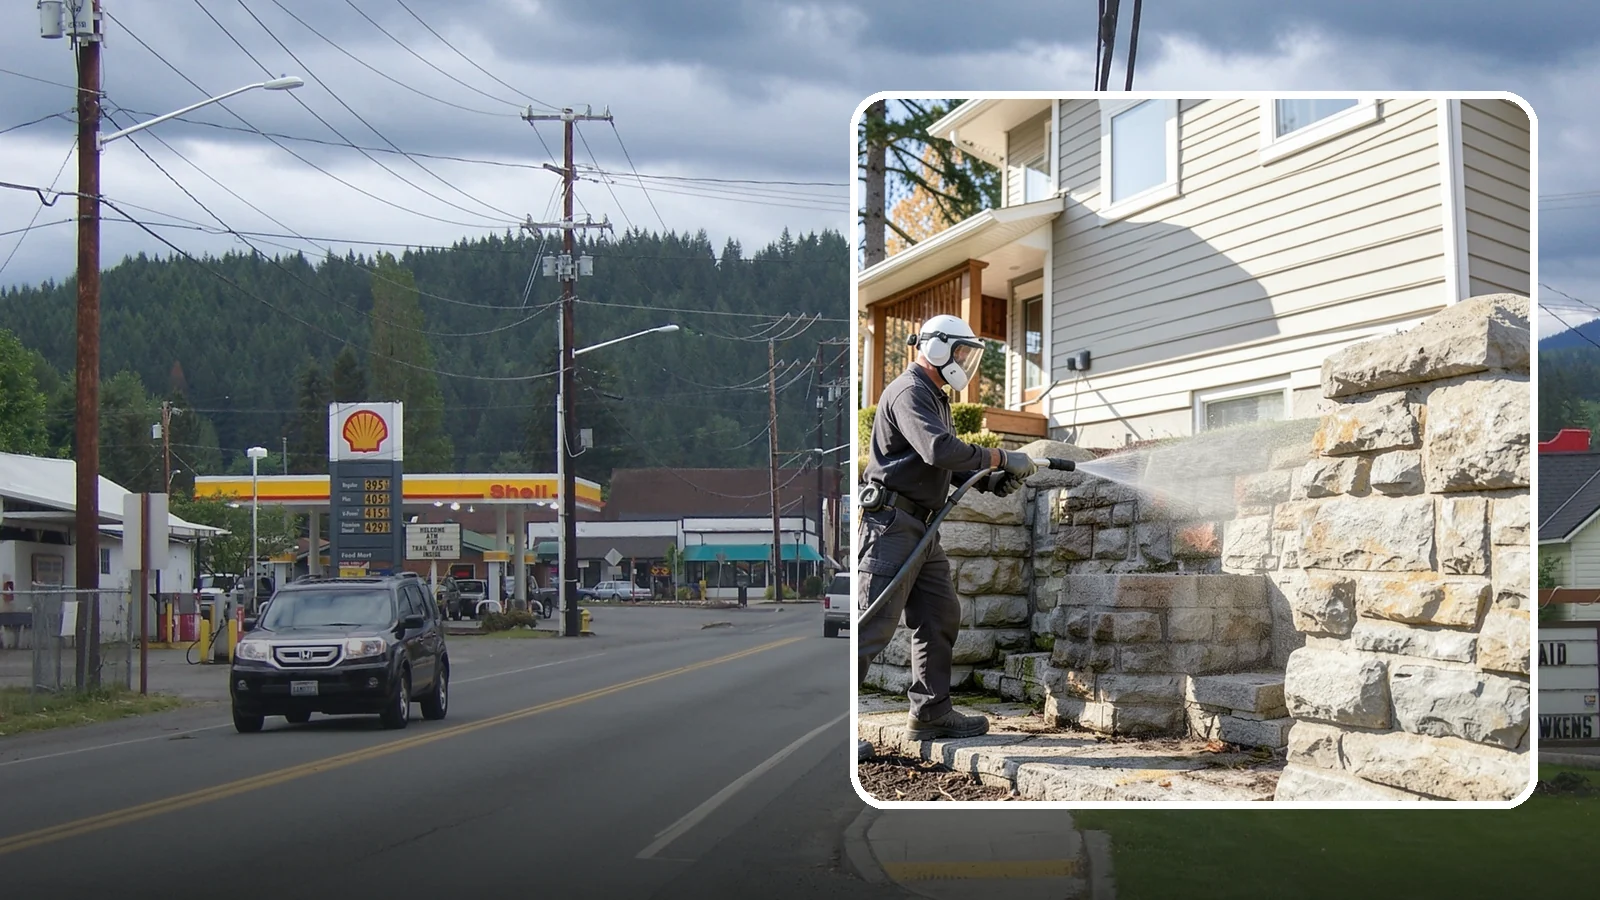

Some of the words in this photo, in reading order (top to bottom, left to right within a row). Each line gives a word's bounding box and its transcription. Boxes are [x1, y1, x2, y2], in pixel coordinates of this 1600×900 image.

[366, 480, 383, 490] 395
[490, 484, 547, 499] Shell
[366, 494, 383, 504] 405
[366, 508, 383, 518] 415
[366, 522, 383, 532] 429
